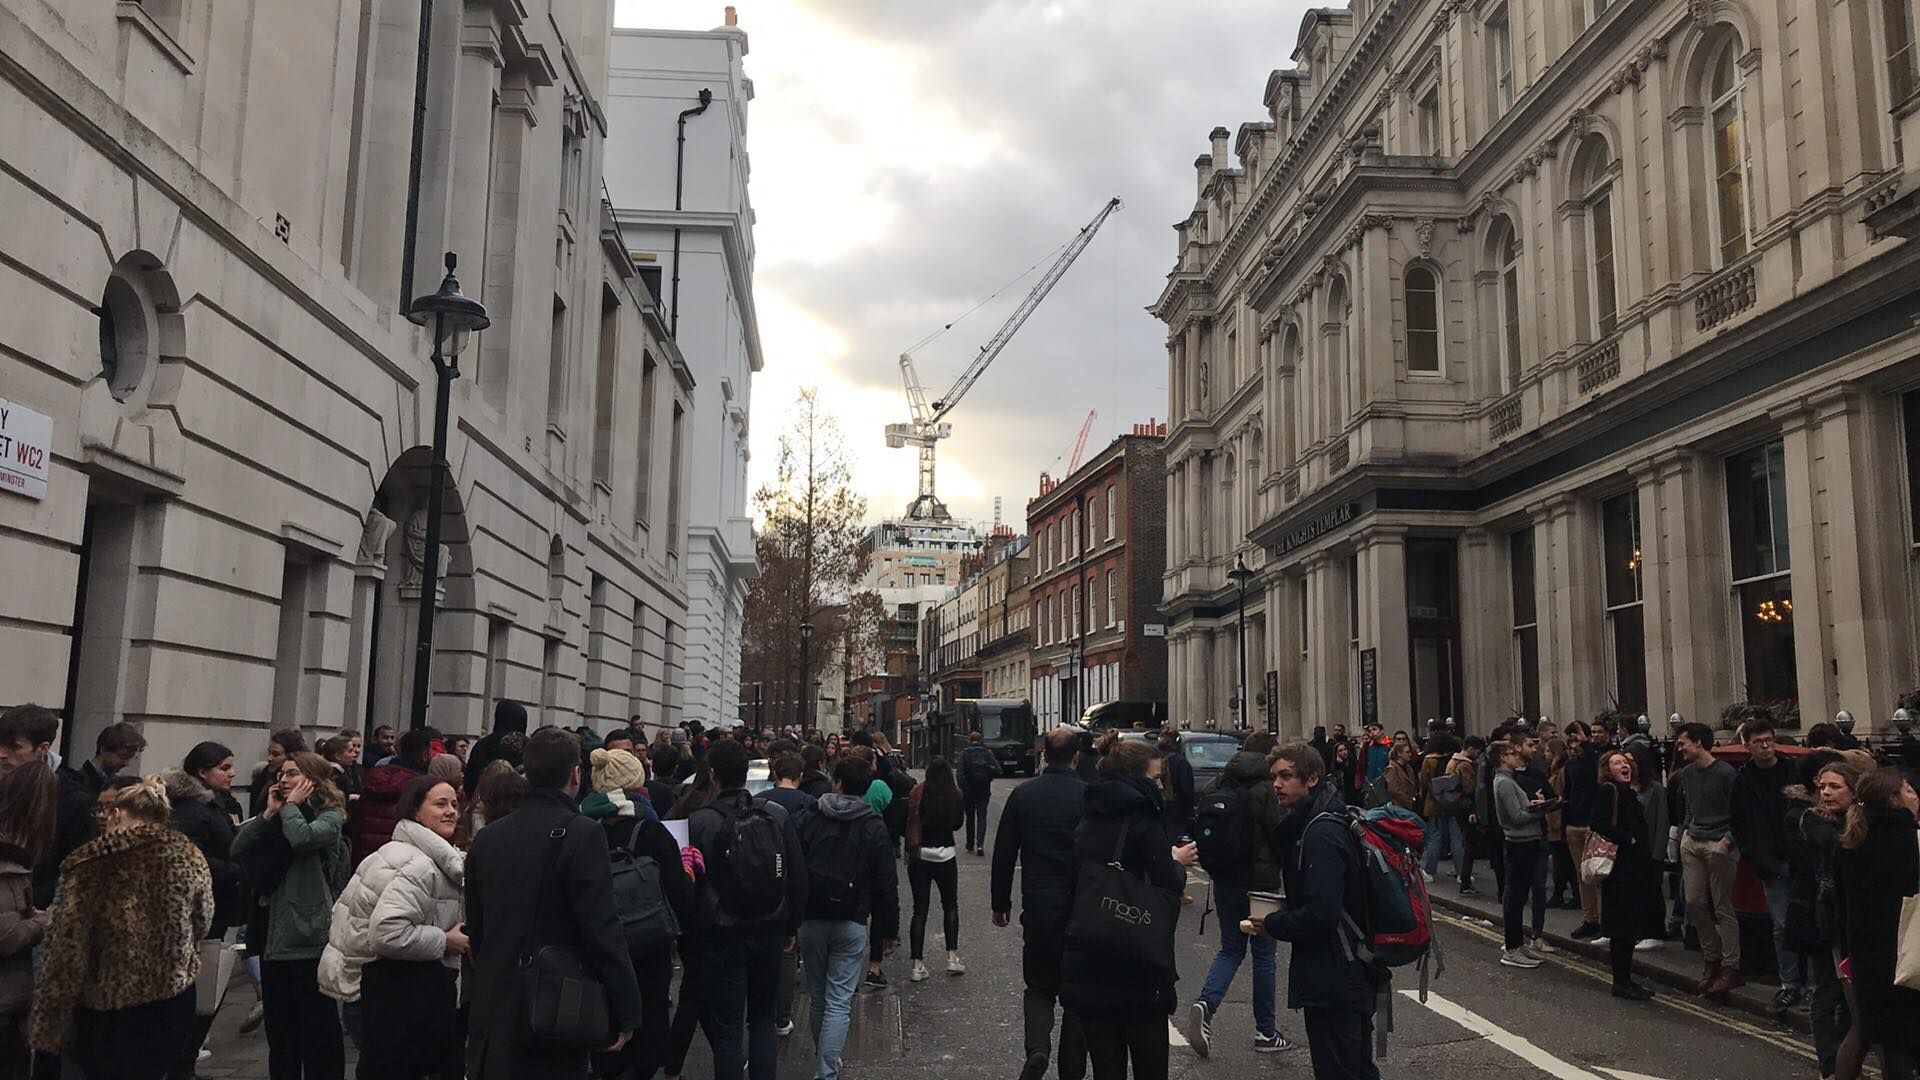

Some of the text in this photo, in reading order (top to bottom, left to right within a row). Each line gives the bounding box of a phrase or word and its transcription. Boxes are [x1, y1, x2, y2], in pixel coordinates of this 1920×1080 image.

[17, 441, 43, 469] WC2
[1286, 523, 1315, 551] KNIGHTS
[1315, 502, 1351, 536] TEMPLAR
